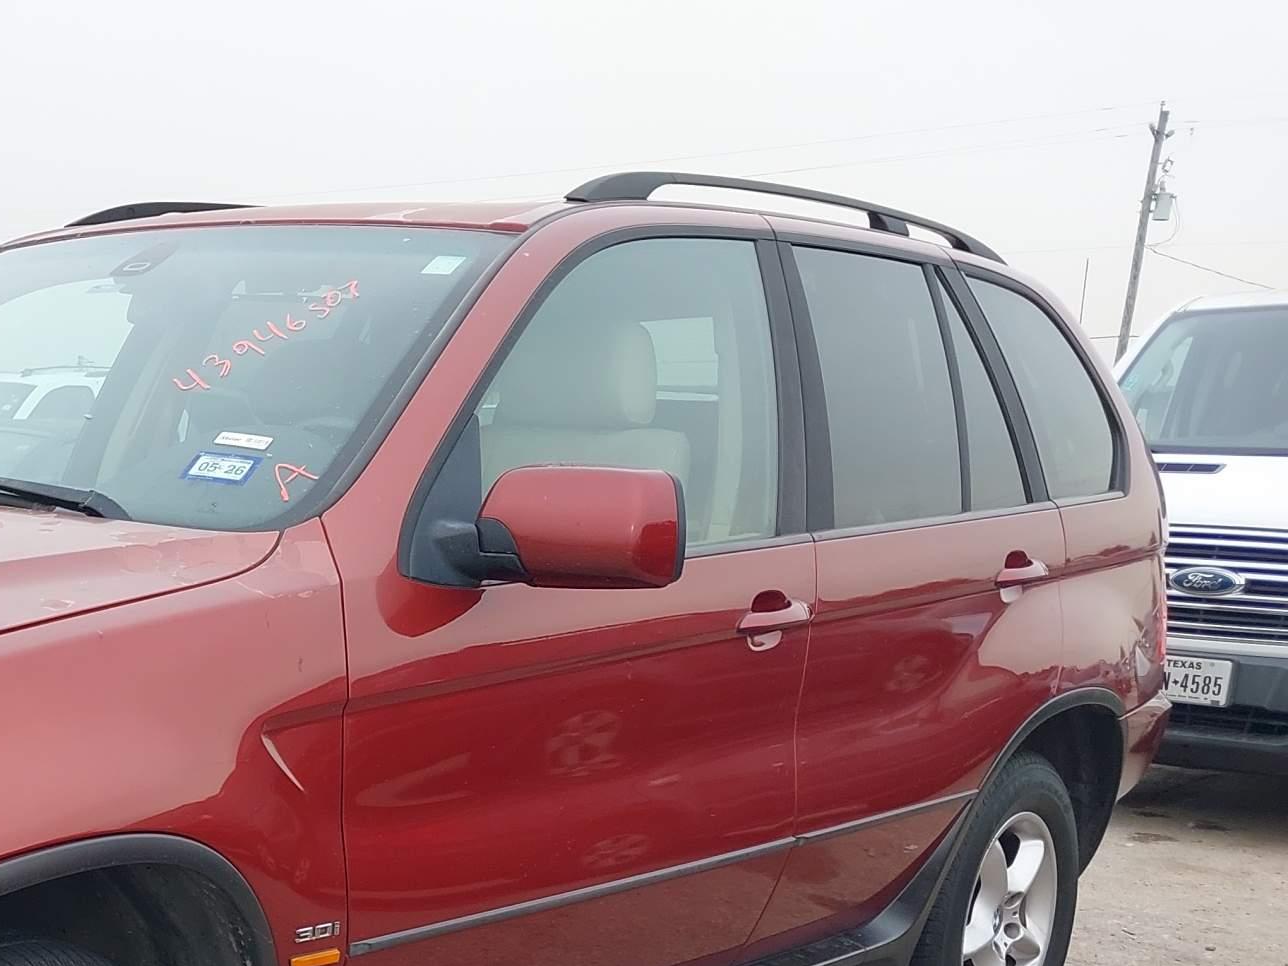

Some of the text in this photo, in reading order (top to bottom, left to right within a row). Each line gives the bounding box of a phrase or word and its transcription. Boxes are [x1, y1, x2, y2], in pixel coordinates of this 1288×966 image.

[197, 461, 247, 476] 05 26
[273, 462, 319, 502] A
[1183, 572, 1223, 589] Ford
[1166, 658, 1202, 670] TEXAS
